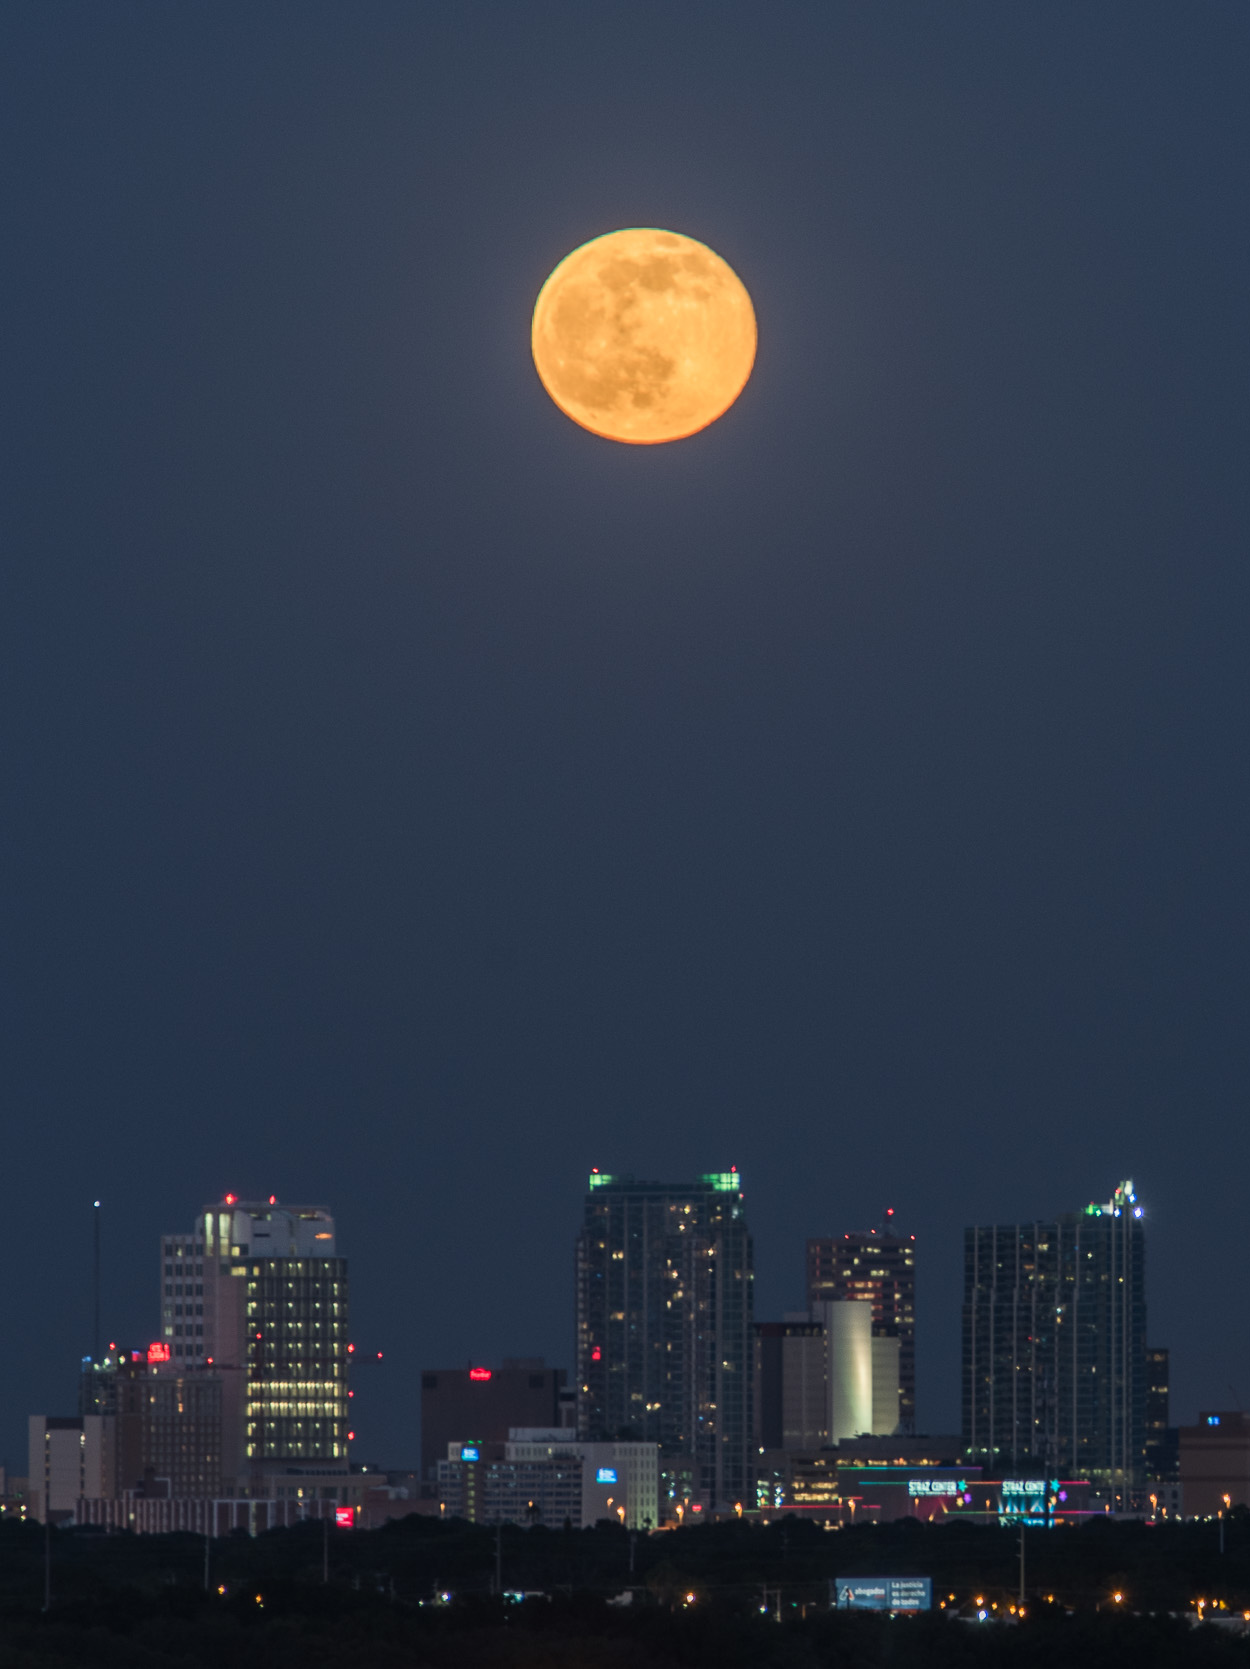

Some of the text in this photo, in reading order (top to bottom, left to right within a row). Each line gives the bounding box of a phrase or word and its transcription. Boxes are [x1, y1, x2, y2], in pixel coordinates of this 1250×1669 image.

[908, 1480, 957, 1491] STRAZ CENTER
[1002, 1480, 1045, 1491] STRAZ CENTE
